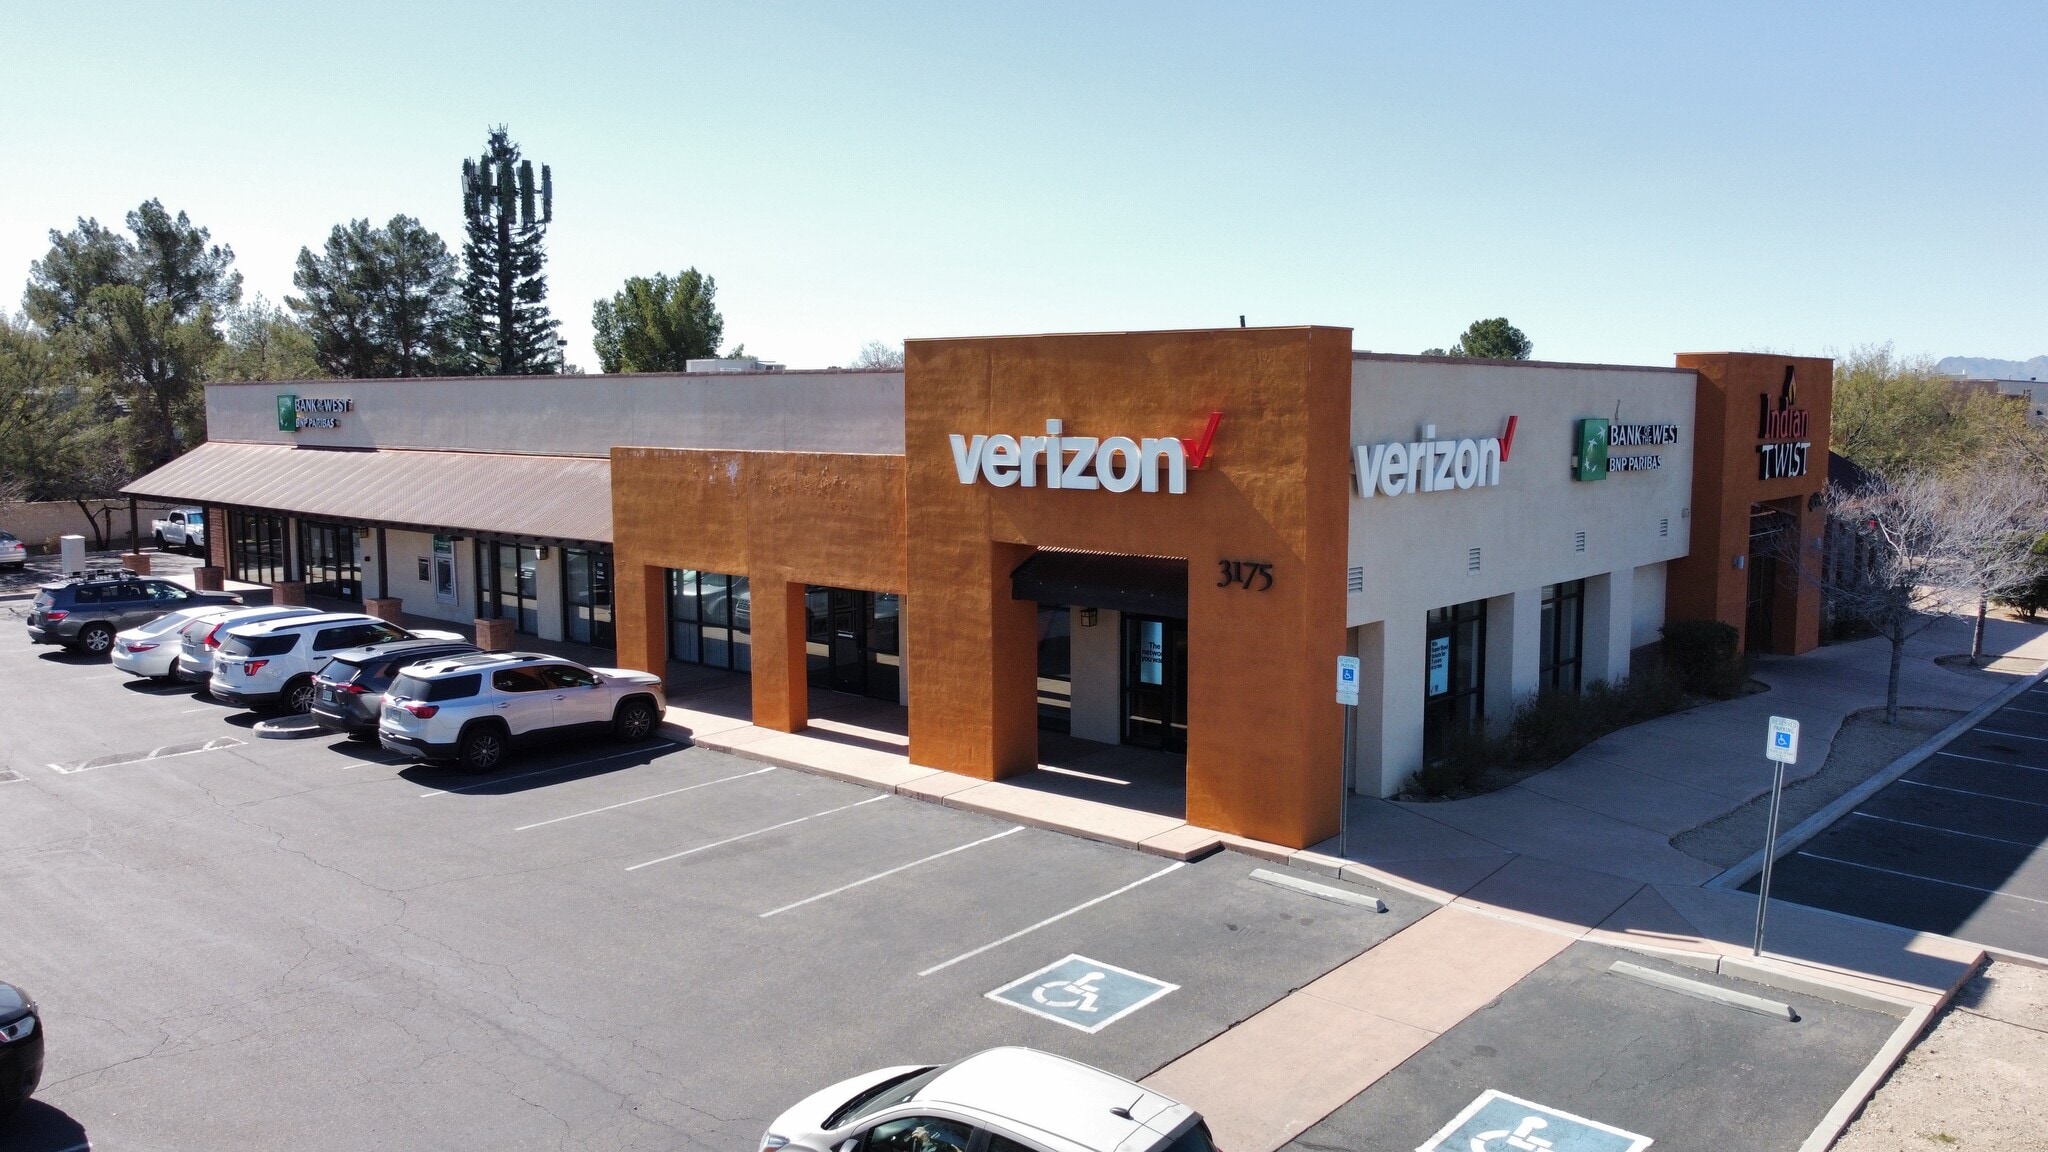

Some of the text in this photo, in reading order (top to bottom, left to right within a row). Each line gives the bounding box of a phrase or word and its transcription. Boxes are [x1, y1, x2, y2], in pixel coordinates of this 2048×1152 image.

[295, 398, 317, 412] BANK
[324, 398, 353, 412] WEST
[295, 417, 335, 428] BNP PARIBAS
[1764, 393, 1810, 439] Indian
[1610, 425, 1680, 446] BANK OF THE WEST
[949, 418, 1187, 495] verizon
[1356, 423, 1501, 498] verizon
[1609, 455, 1662, 472] BNP PARIBAS
[1762, 442, 1812, 480] TWIST
[1216, 559, 1273, 592] 3175
[1141, 649, 1162, 657] netwo
[1148, 641, 1161, 650] The
